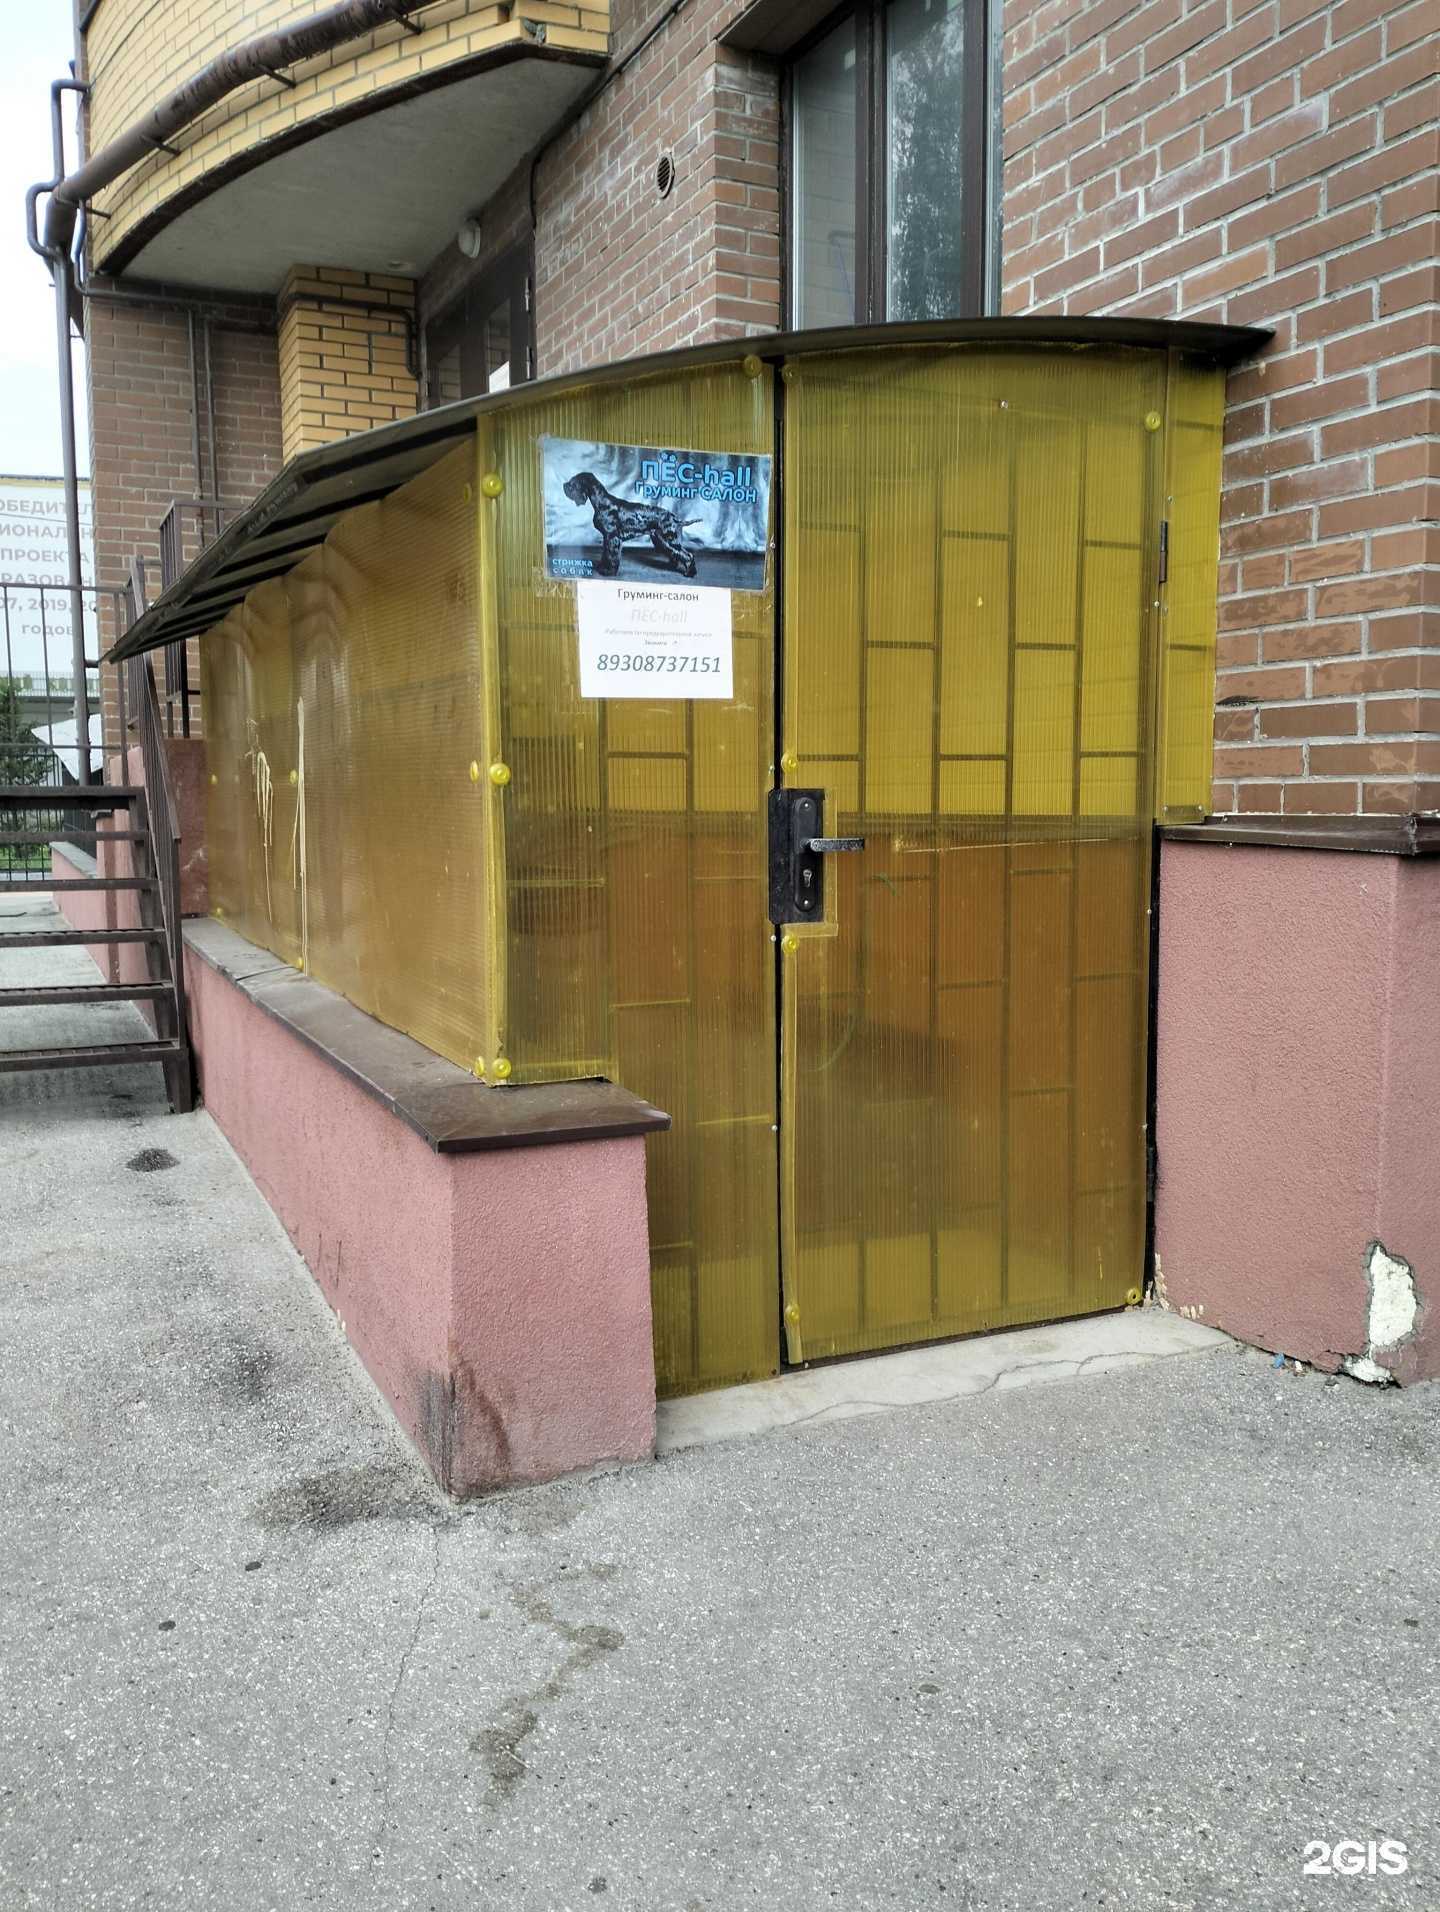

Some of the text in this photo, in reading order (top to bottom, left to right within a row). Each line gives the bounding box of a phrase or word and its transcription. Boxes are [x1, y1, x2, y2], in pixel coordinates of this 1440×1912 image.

[701, 487, 757, 503] САЛОН
[1, 548, 90, 564] ПРОЕКА
[617, 588, 699, 601] Груминг-салон
[597, 654, 721, 673] 89308737151
